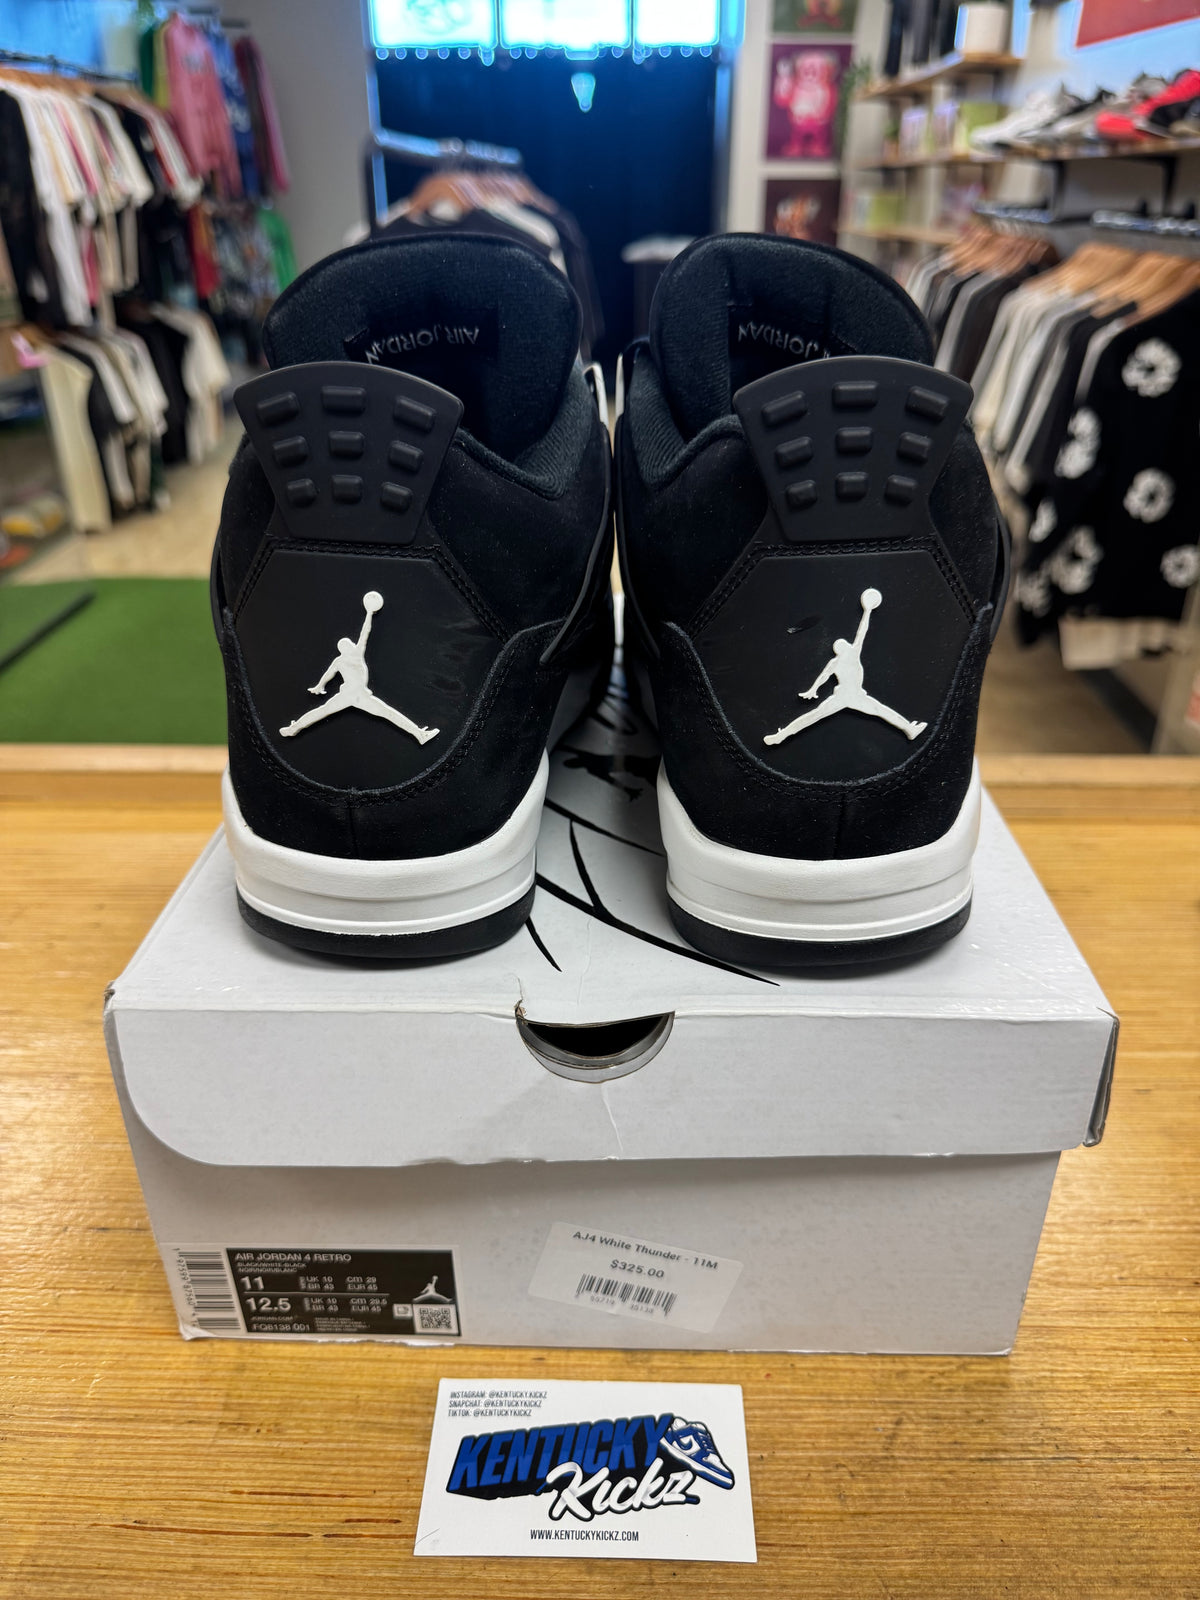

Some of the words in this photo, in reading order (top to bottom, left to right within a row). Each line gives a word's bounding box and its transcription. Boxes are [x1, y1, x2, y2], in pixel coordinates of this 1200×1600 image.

[444, 326, 480, 344] AIR
[738, 321, 819, 359] JORDAN
[365, 324, 441, 364] JORDAN
[235, 1252, 254, 1260] AIR
[257, 1252, 302, 1260] JORDAN
[304, 1253, 311, 1261] 4
[314, 1253, 352, 1262] RETRO
[572, 1231, 596, 1243] AJ4
[600, 1236, 631, 1250] White
[635, 1243, 681, 1261] Thunder
[693, 1256, 718, 1270] 11M
[610, 1259, 665, 1279] $325.00
[240, 1276, 264, 1290] 11
[245, 1297, 291, 1311] 12.5
[292, 1322, 310, 1331] 001
[450, 1390, 486, 1399] INSTAGRAM:
[448, 1399, 482, 1408] SNAPCHAT:
[484, 1400, 542, 1408] @KENTUCKYKICKZ
[448, 1409, 472, 1417] TIKTOK:
[473, 1409, 532, 1417] @KENTUCKYKICKZ
[449, 1413, 674, 1492] KENTUCKY
[545, 1457, 698, 1521] Kickz
[530, 1529, 639, 1541] WWW.KENTUCKYKICKZ.COM
